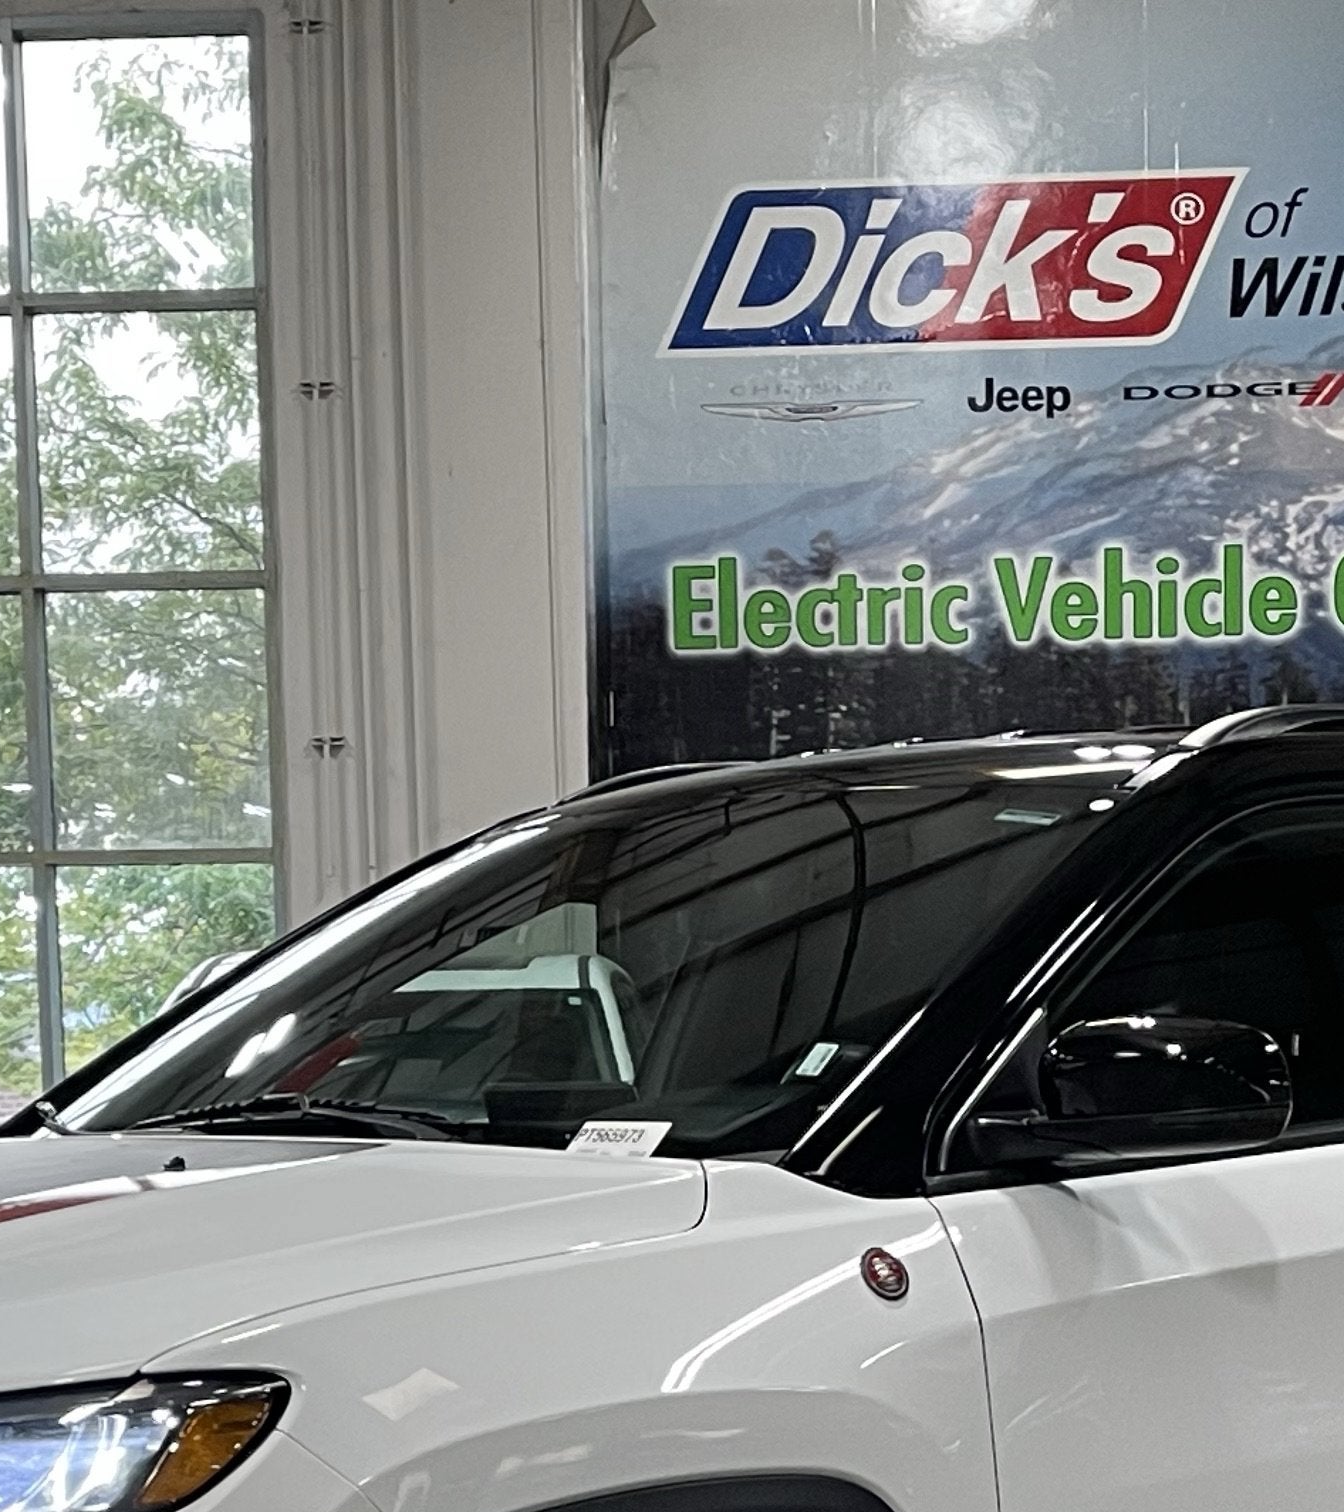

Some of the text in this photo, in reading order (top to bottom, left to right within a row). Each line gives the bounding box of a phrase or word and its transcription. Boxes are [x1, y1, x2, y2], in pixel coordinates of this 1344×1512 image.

[1245, 186, 1309, 239] of
[966, 377, 1071, 419] Jeep
[1122, 380, 1320, 401] DODGE
[671, 555, 969, 650] Electric
[993, 543, 1300, 643] Vehicle
